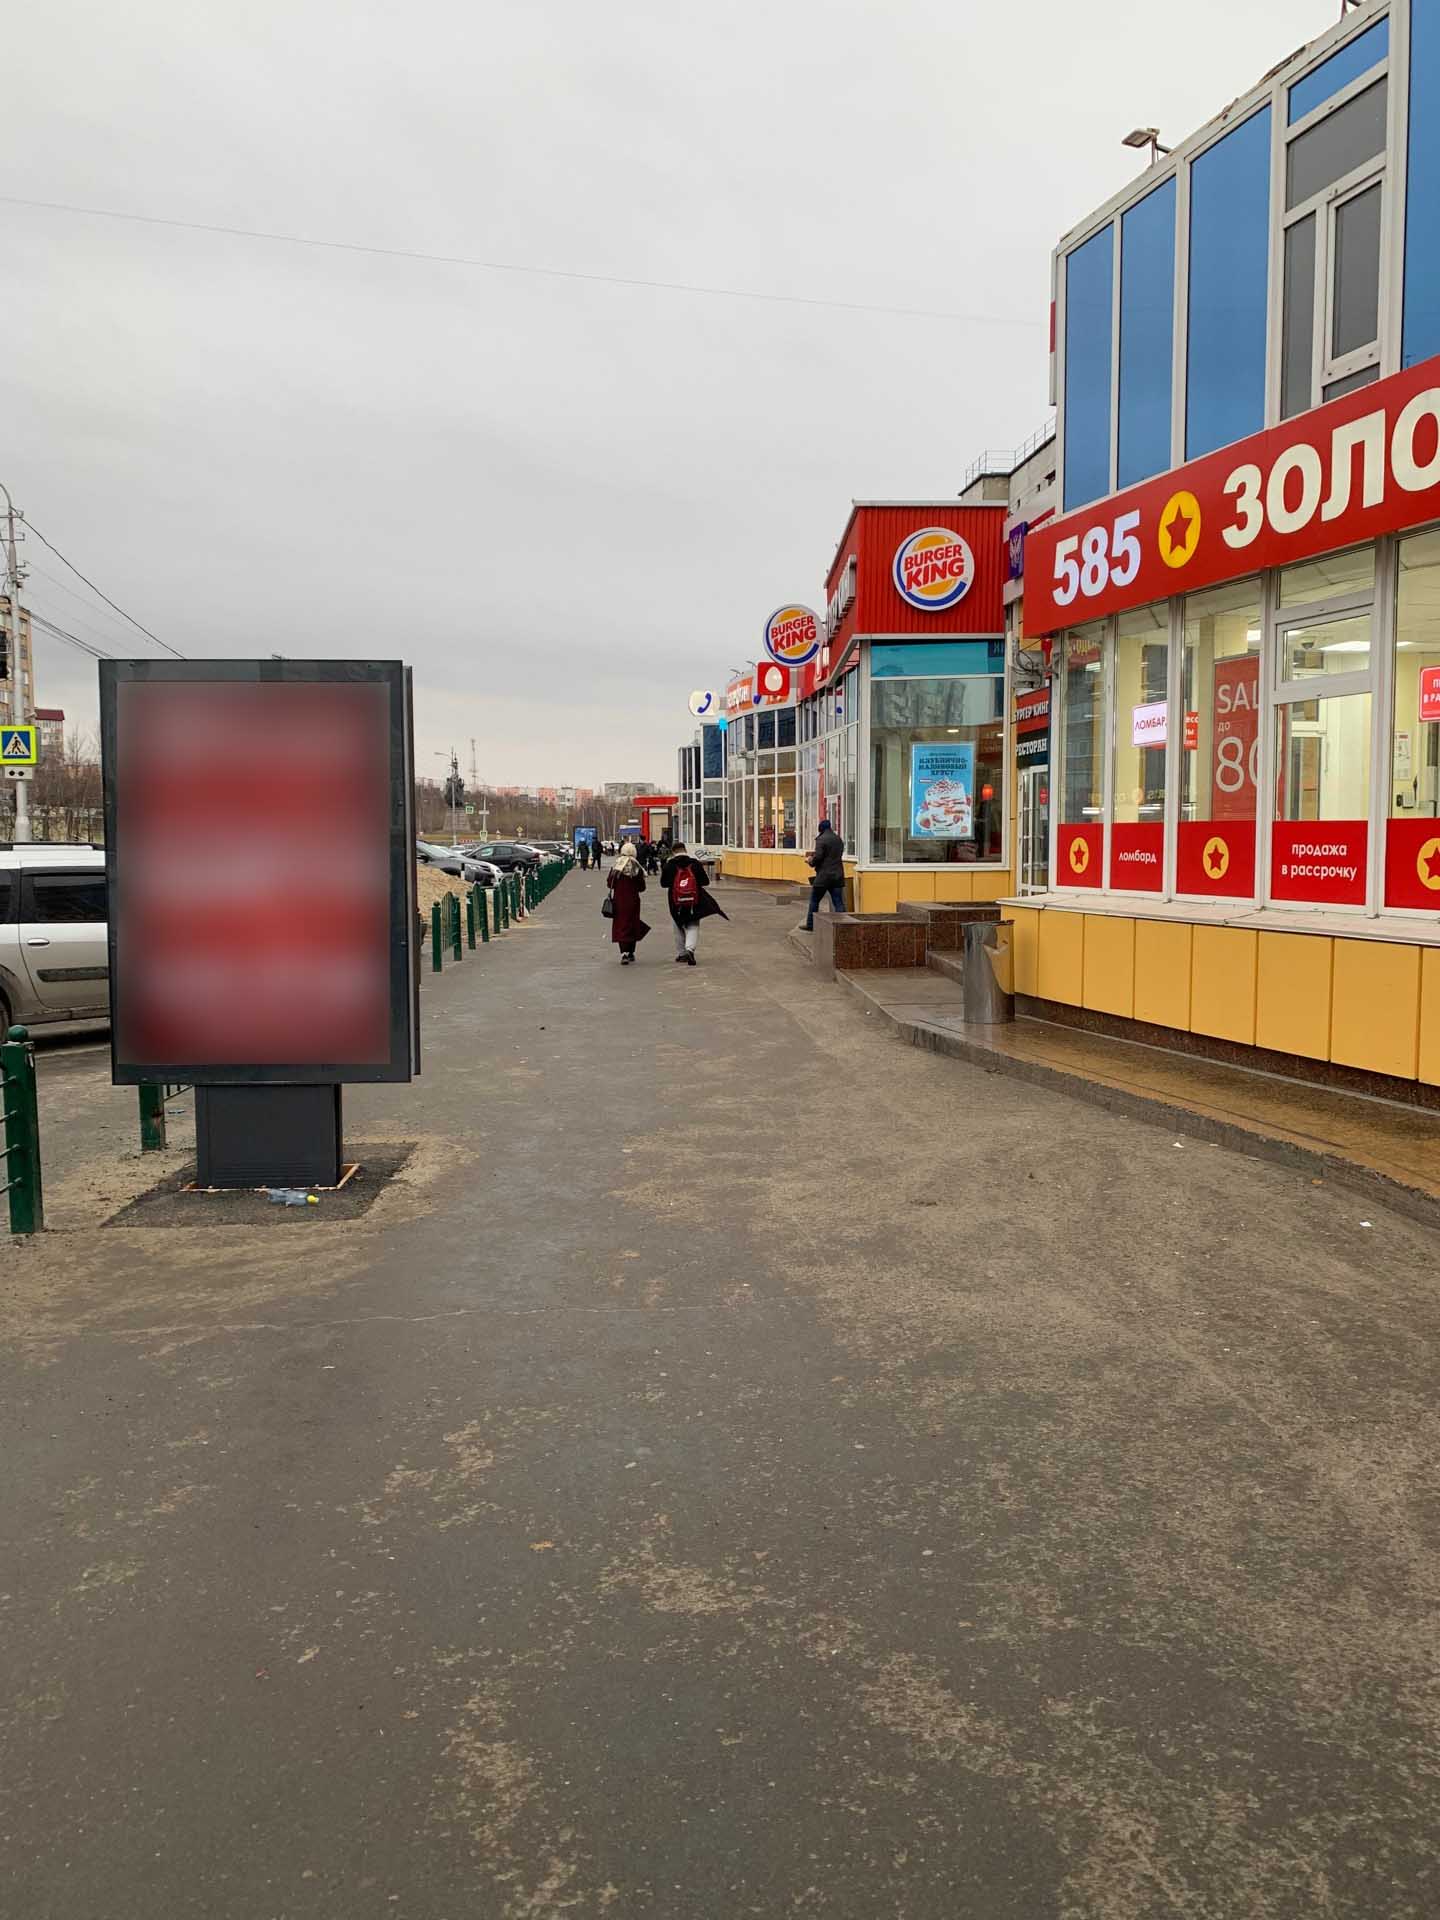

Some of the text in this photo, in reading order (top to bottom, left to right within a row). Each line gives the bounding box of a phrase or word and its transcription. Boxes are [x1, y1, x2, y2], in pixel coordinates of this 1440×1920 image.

[1052, 388, 1440, 607] 585 ЗОЛО
[904, 544, 962, 572] BURGER
[906, 558, 964, 592] KING
[771, 615, 814, 640] BURGER
[773, 626, 816, 653] KING
[1016, 701, 1048, 721] УРГЕР КИНГ
[1135, 716, 1167, 731] ЛОМБАР
[1218, 721, 1232, 733] до
[1016, 738, 1047, 757] РЕСТОРАН
[1118, 849, 1157, 865] ломбард
[1291, 844, 1348, 858] продажа
[1281, 864, 1358, 881] в рассрочку
